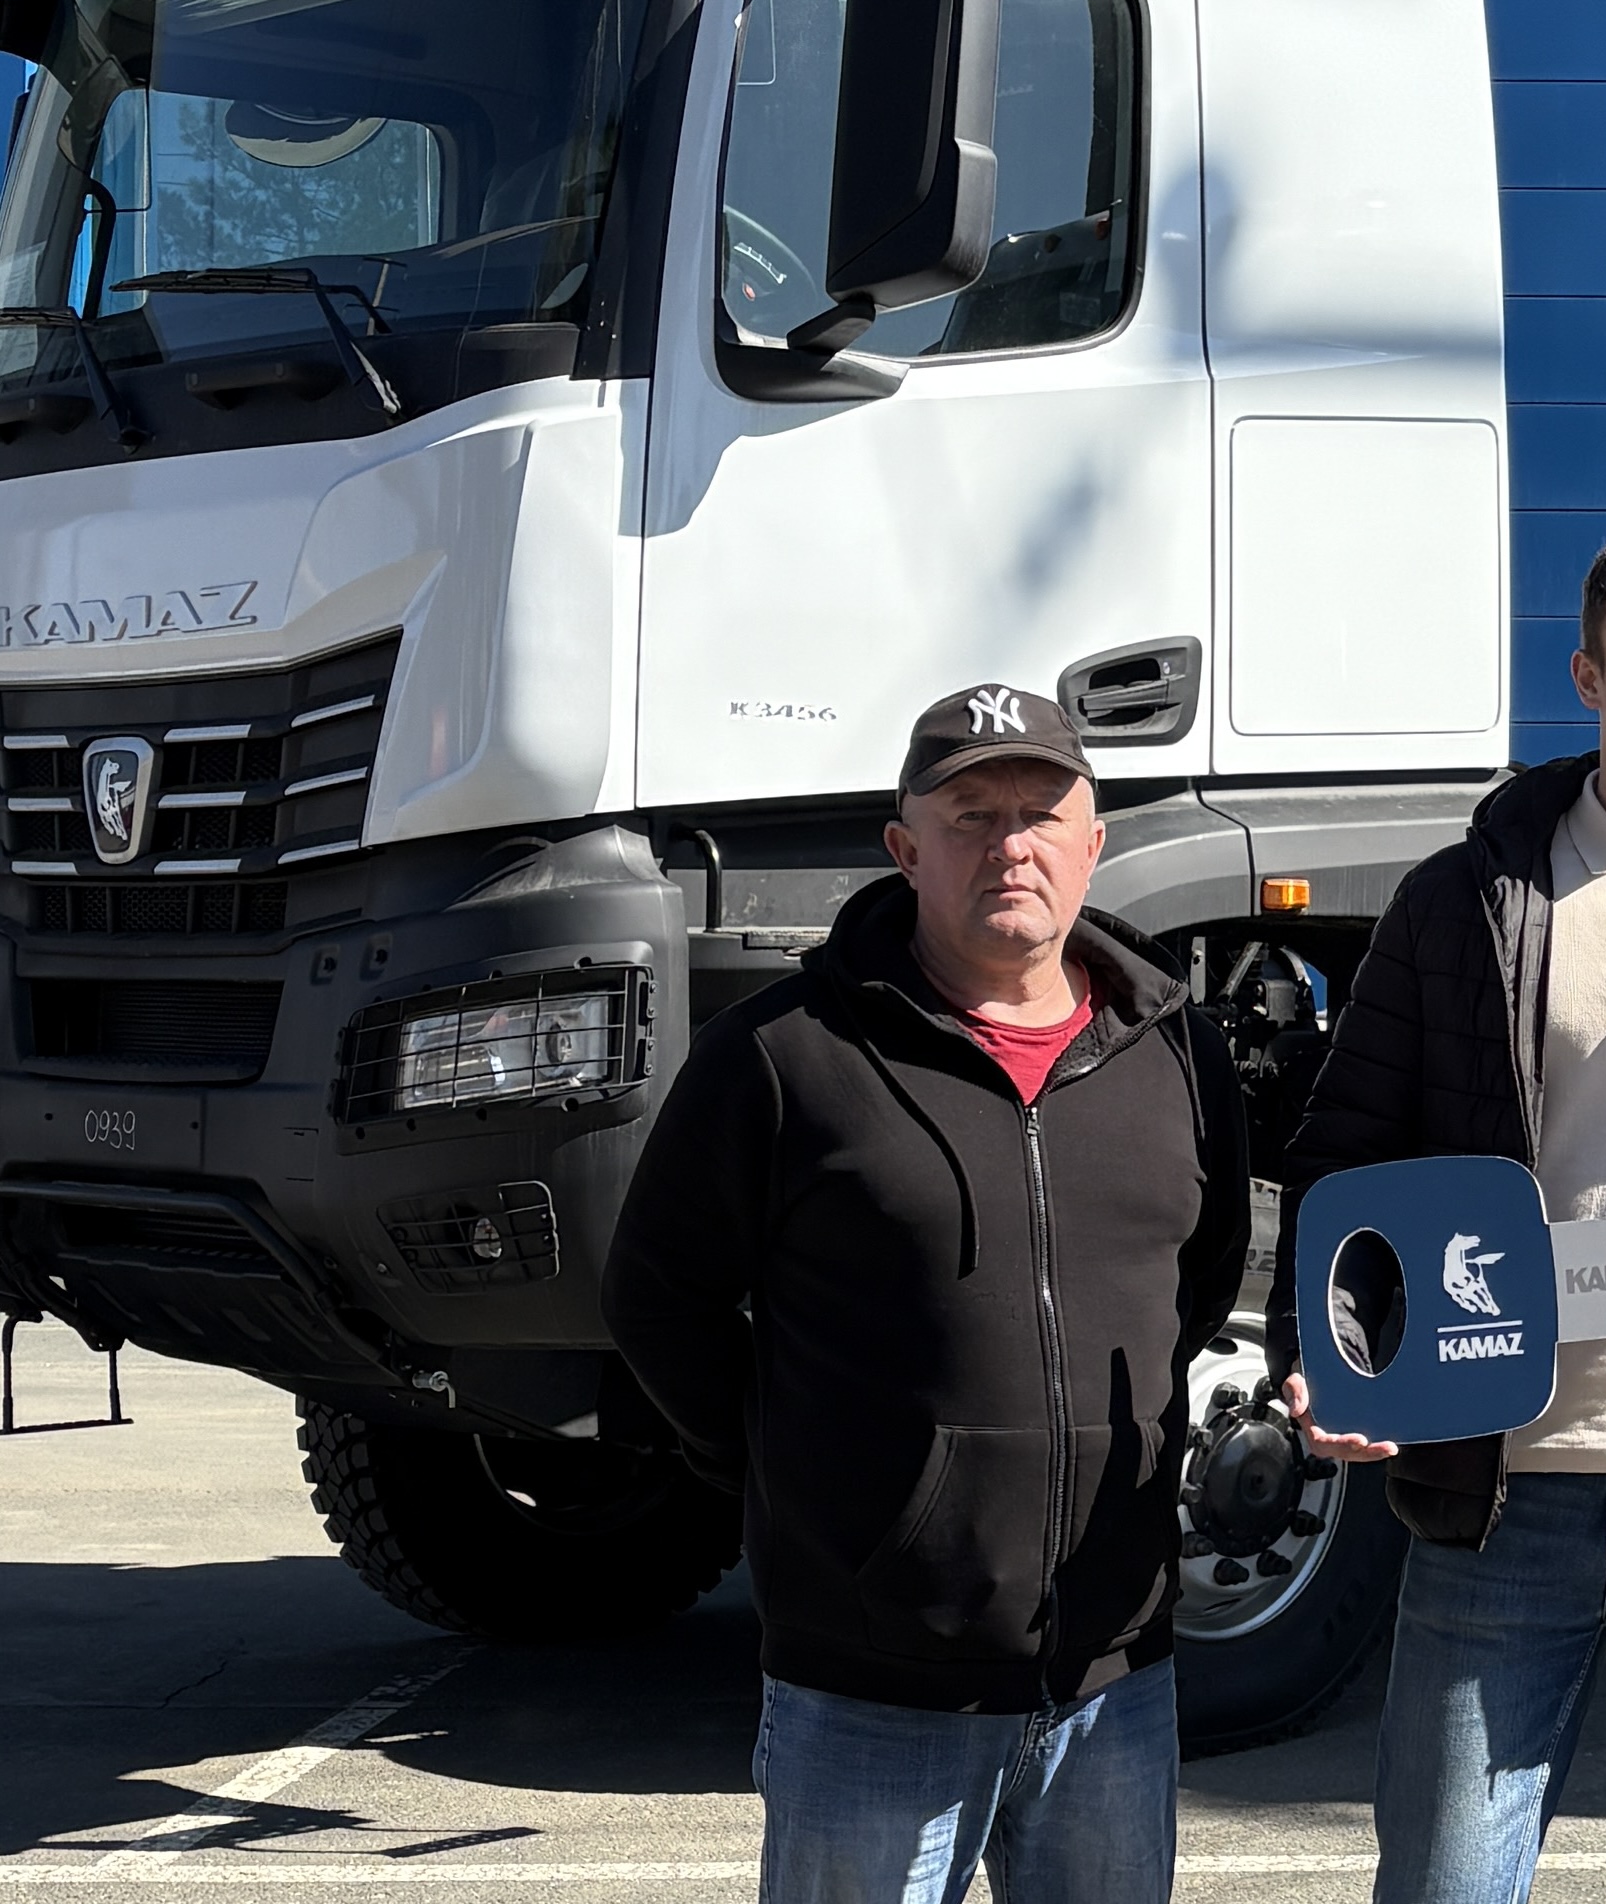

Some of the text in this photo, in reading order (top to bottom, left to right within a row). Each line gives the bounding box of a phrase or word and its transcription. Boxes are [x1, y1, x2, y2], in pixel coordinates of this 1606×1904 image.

[0, 580, 259, 647] KAMAZ
[967, 687, 1026, 735] NY
[84, 1109, 136, 1151] 0939
[1438, 1332, 1525, 1363] KAMAZ
